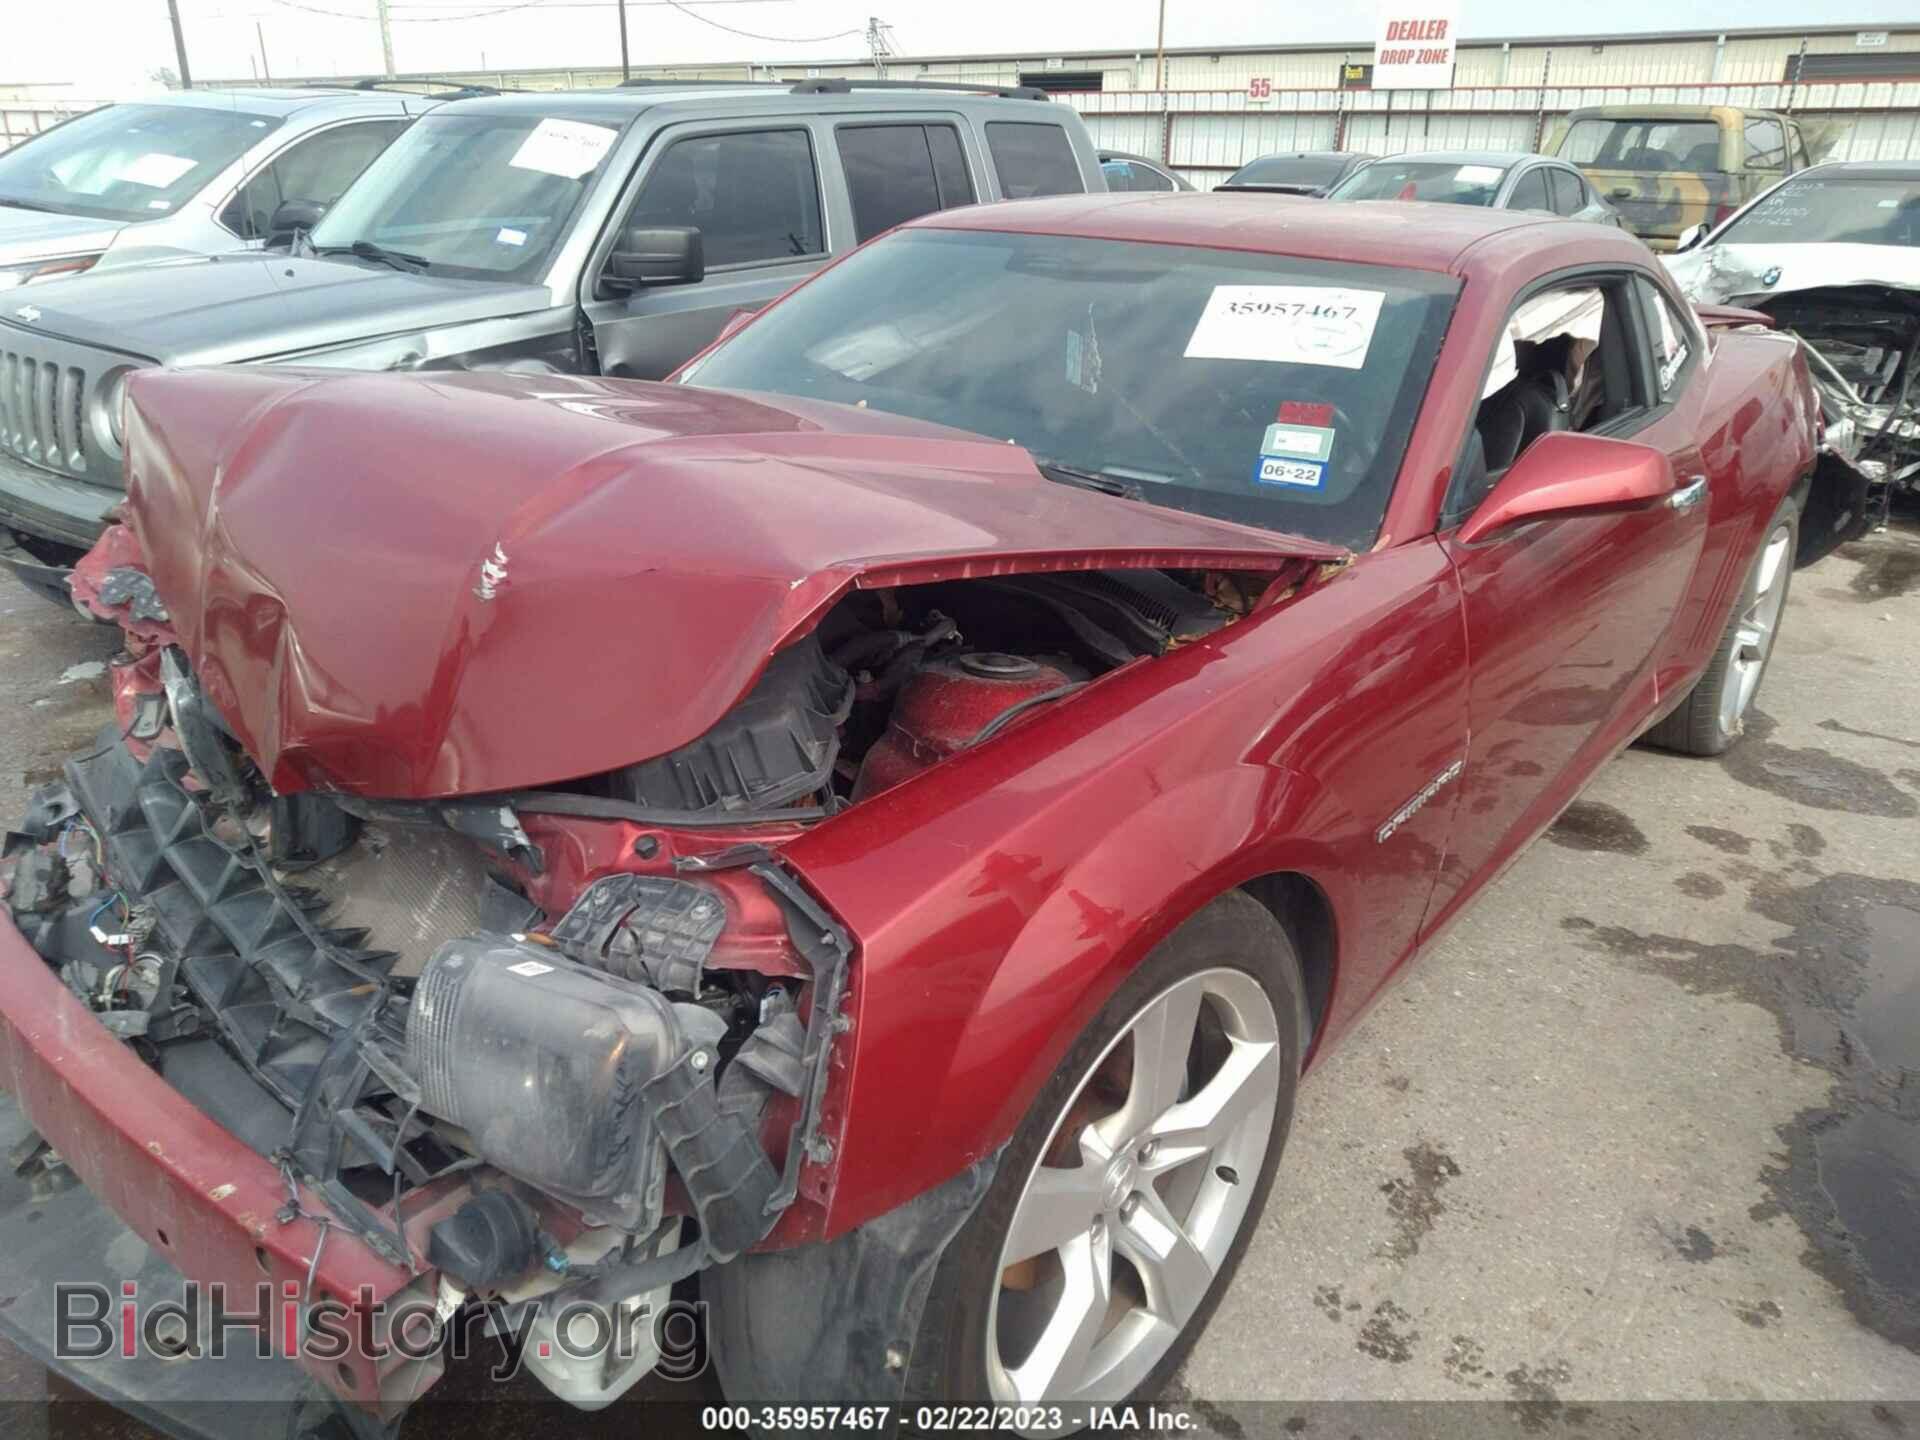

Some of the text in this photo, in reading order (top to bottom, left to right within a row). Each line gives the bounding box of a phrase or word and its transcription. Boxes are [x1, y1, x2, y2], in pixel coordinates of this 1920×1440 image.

[1385, 19, 1449, 41] DEALER
[1379, 48, 1450, 65] DROP ZONE
[1250, 77, 1271, 98] 55
[1222, 301, 1358, 320] 35957467
[1263, 463, 1317, 482] 06-22
